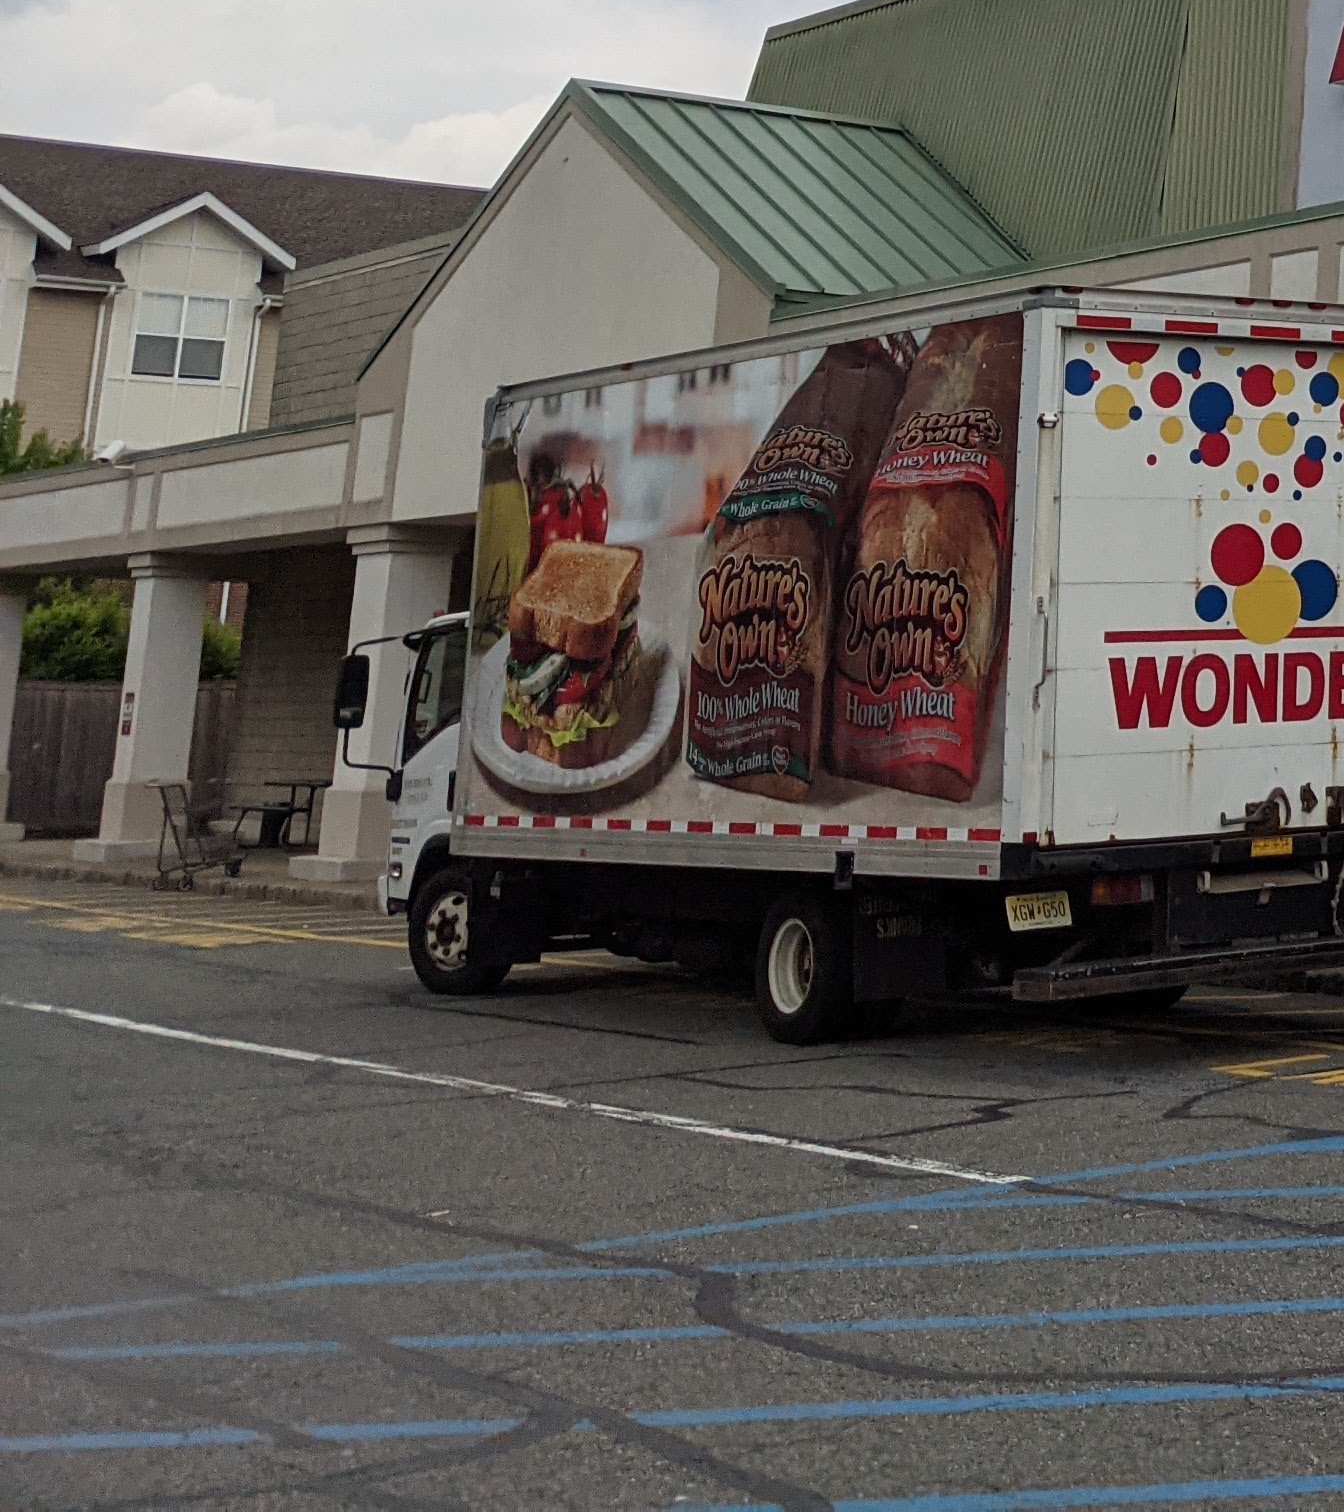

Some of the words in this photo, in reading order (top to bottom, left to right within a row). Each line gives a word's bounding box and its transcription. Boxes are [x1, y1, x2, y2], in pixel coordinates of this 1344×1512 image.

[898, 426, 969, 452] Own
[756, 443, 820, 472] Own
[932, 449, 988, 468] Wheat
[758, 467, 798, 485] Whole
[761, 498, 790, 510] Grain
[699, 554, 810, 645] Nature's
[845, 558, 968, 655] Nature's
[717, 614, 779, 685] Own
[866, 622, 934, 695] Own
[697, 691, 725, 723] 100%
[725, 687, 760, 721] Whole
[761, 680, 800, 714] Wheat
[846, 691, 897, 732] Honey
[901, 687, 956, 721] Wheat
[707, 758, 734, 777] Whole
[736, 751, 762, 774] Grain
[1012, 903, 1036, 922] XGW
[1042, 900, 1066, 918] G50
